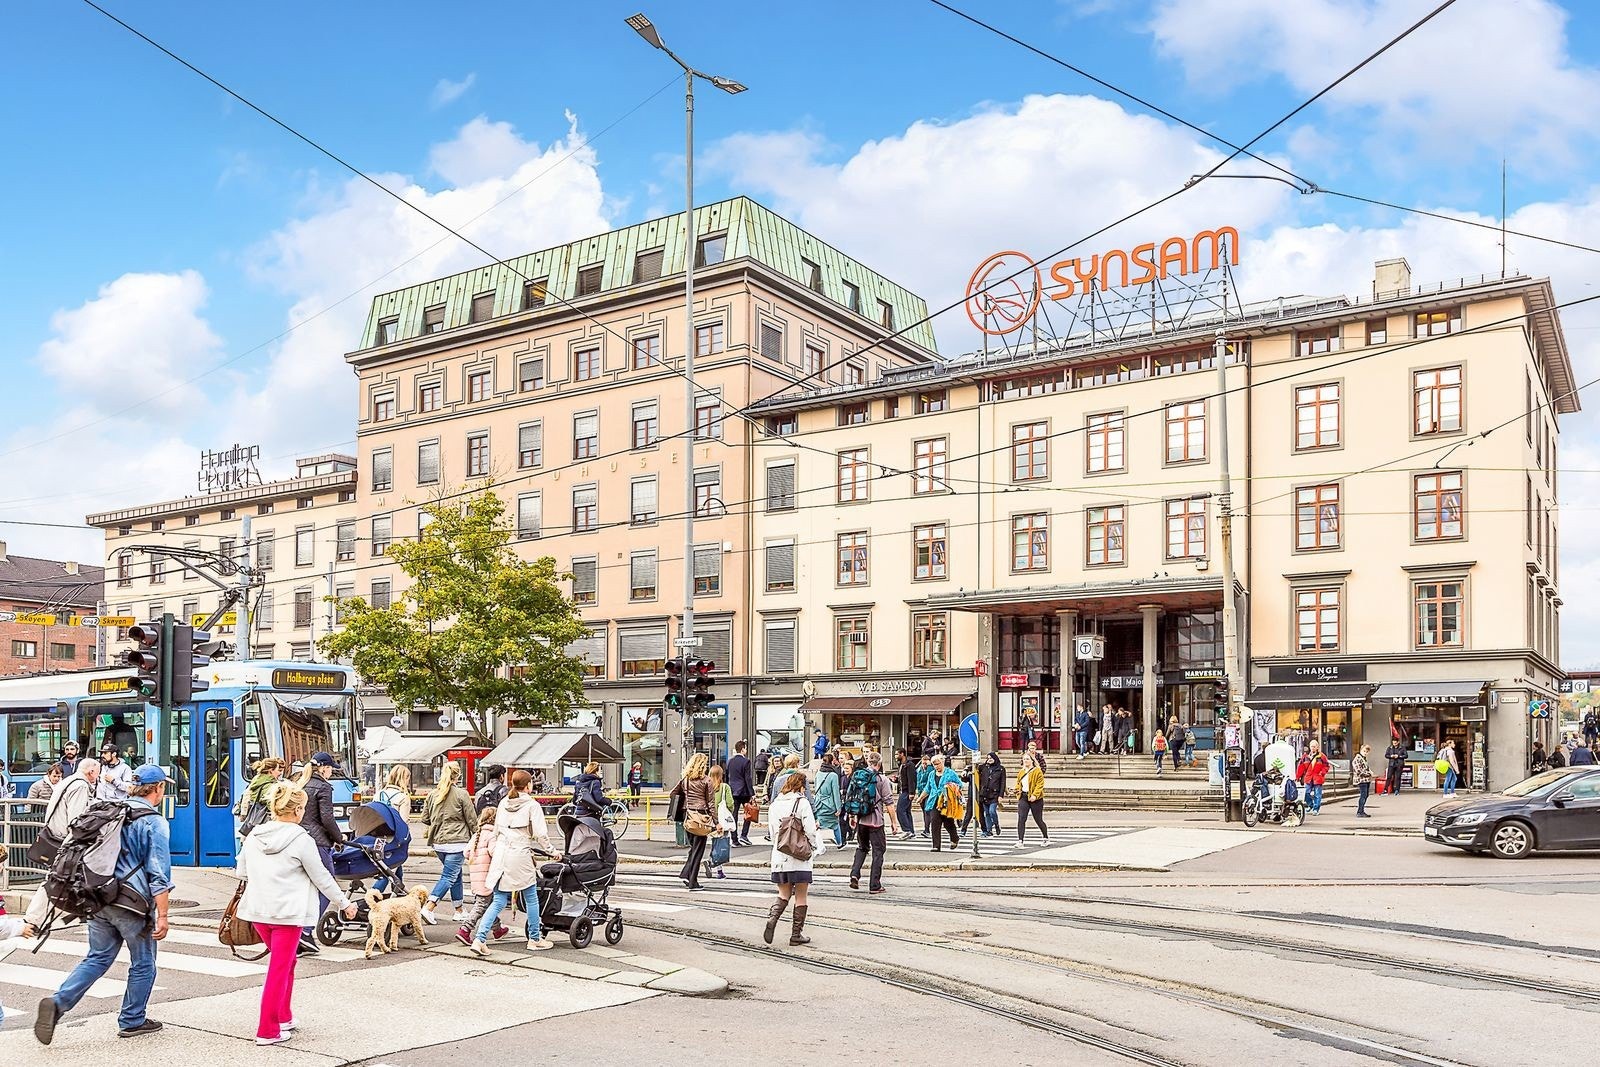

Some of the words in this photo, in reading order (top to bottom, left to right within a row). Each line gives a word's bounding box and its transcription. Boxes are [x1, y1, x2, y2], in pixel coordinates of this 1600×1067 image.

[1051, 226, 1239, 301] SYNSAM
[1296, 666, 1338, 675] CHANGE
[856, 682, 869, 692] W.
[870, 681, 880, 692] B.
[881, 680, 927, 692] SAMSON
[1392, 696, 1458, 704] MAJOREN
[692, 710, 718, 719] ordea
